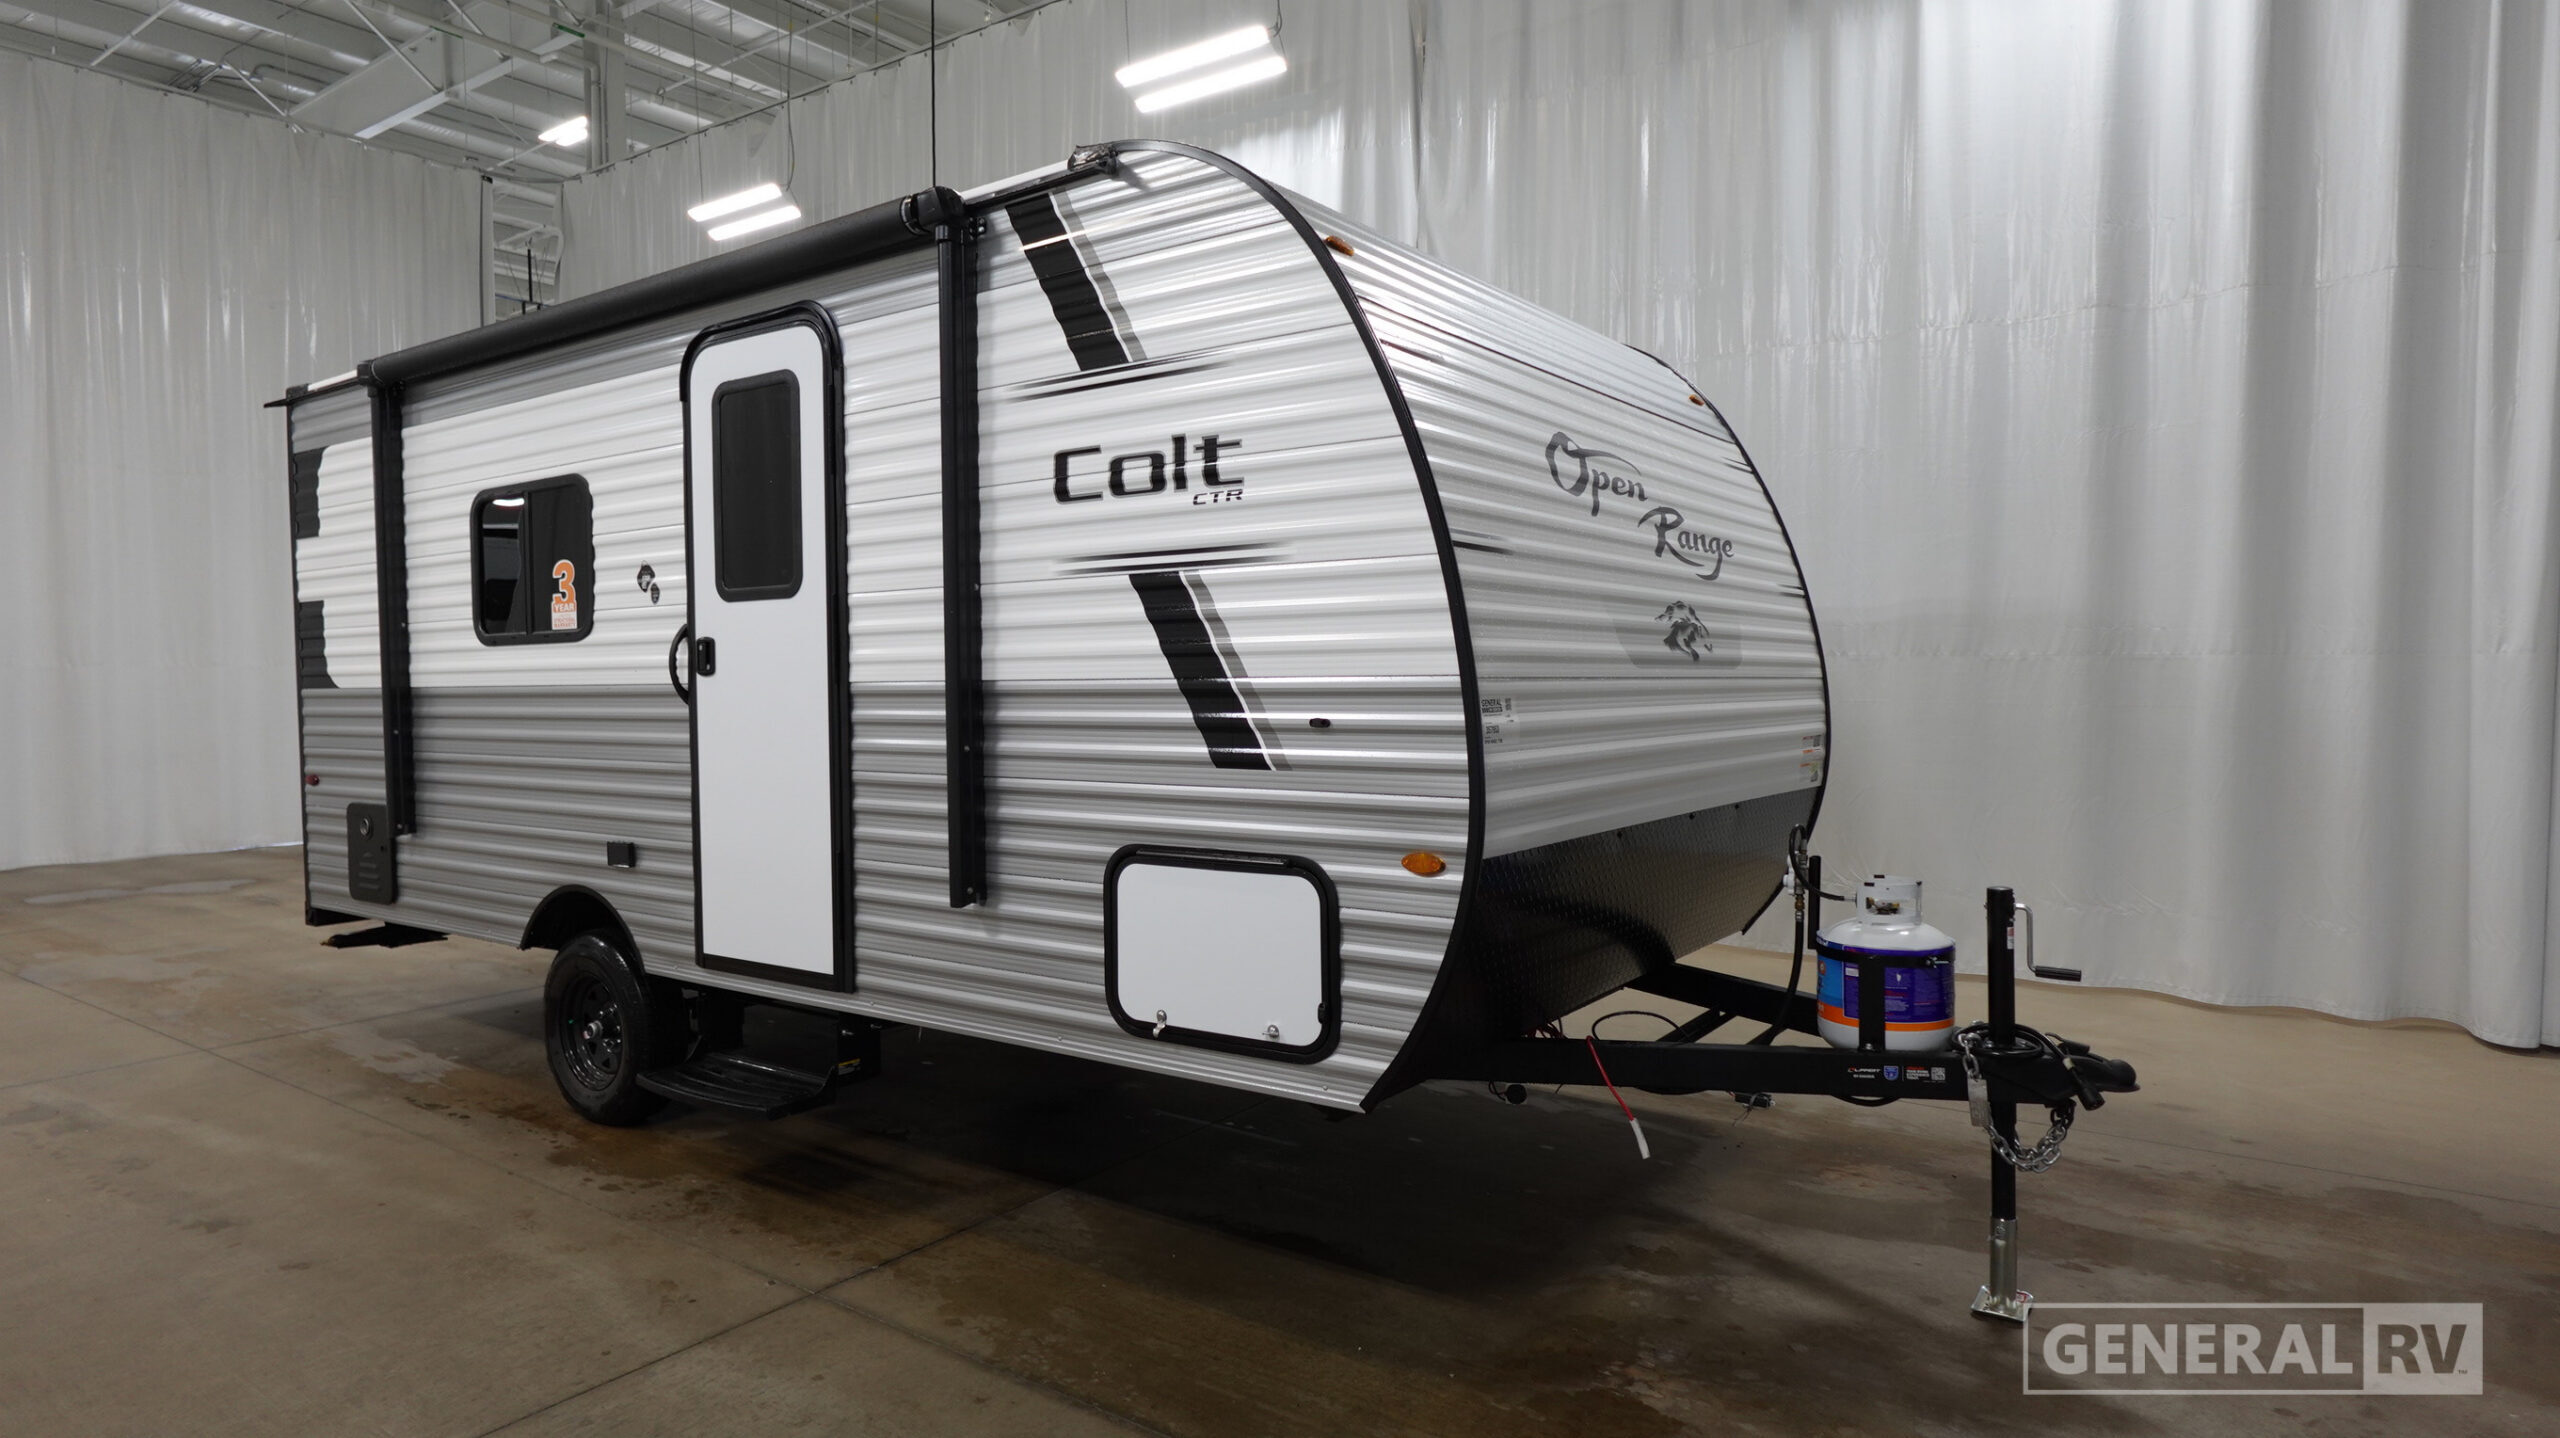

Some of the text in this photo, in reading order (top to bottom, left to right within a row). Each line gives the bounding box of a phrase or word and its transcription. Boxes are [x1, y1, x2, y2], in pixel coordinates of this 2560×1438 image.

[1053, 433, 1244, 504] Colt
[1192, 488, 1243, 505] CTR
[1545, 431, 1648, 517] Open
[1637, 506, 1734, 581] Range
[552, 559, 576, 604] 3
[554, 603, 575, 612] YEAR
